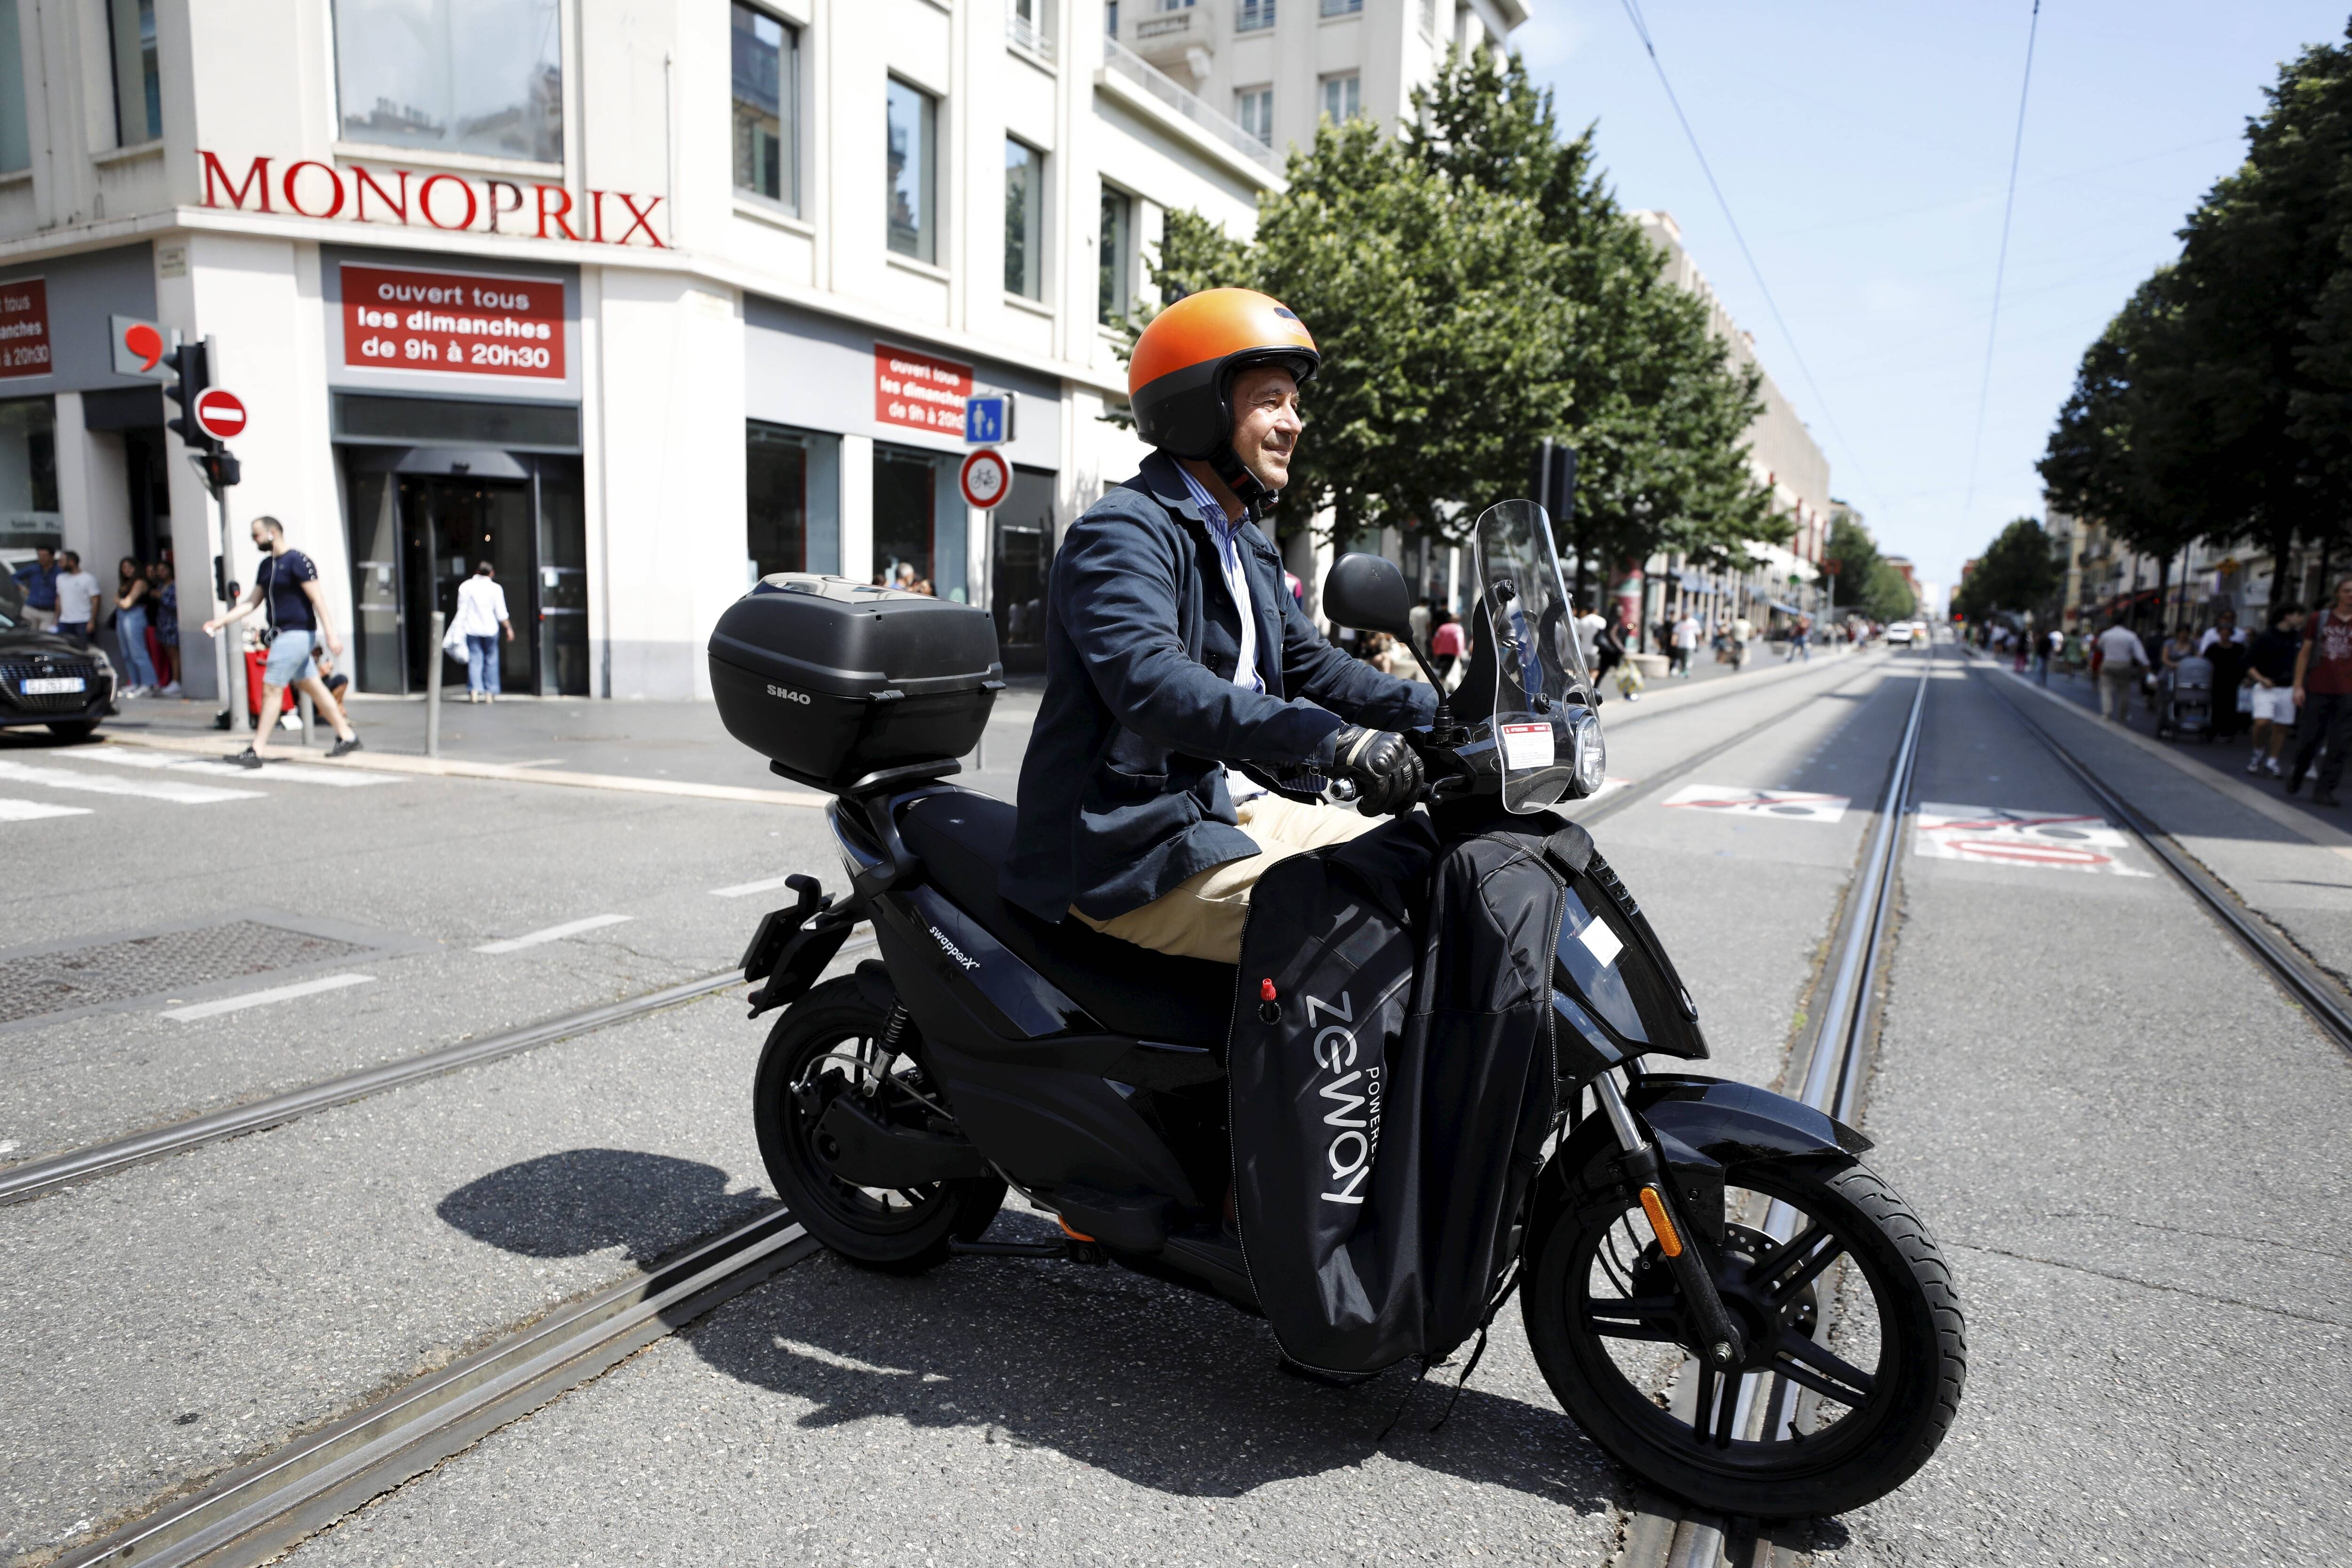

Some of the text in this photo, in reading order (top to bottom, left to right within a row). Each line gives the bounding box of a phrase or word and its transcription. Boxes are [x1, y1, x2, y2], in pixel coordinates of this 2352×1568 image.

[195, 149, 670, 248] MONOPRIX
[4, 294, 32, 313] tous
[378, 283, 530, 310] ouvert tous
[358, 306, 551, 340] les dimanches
[14, 343, 49, 366] 20h30
[361, 336, 550, 368] de 9h à 20h30
[880, 375, 901, 395] les
[890, 358, 960, 387] ouvert tous
[889, 401, 965, 430] de 9h à 20h3
[767, 685, 810, 705] SH40
[1366, 1067, 1380, 1165] POWERE
